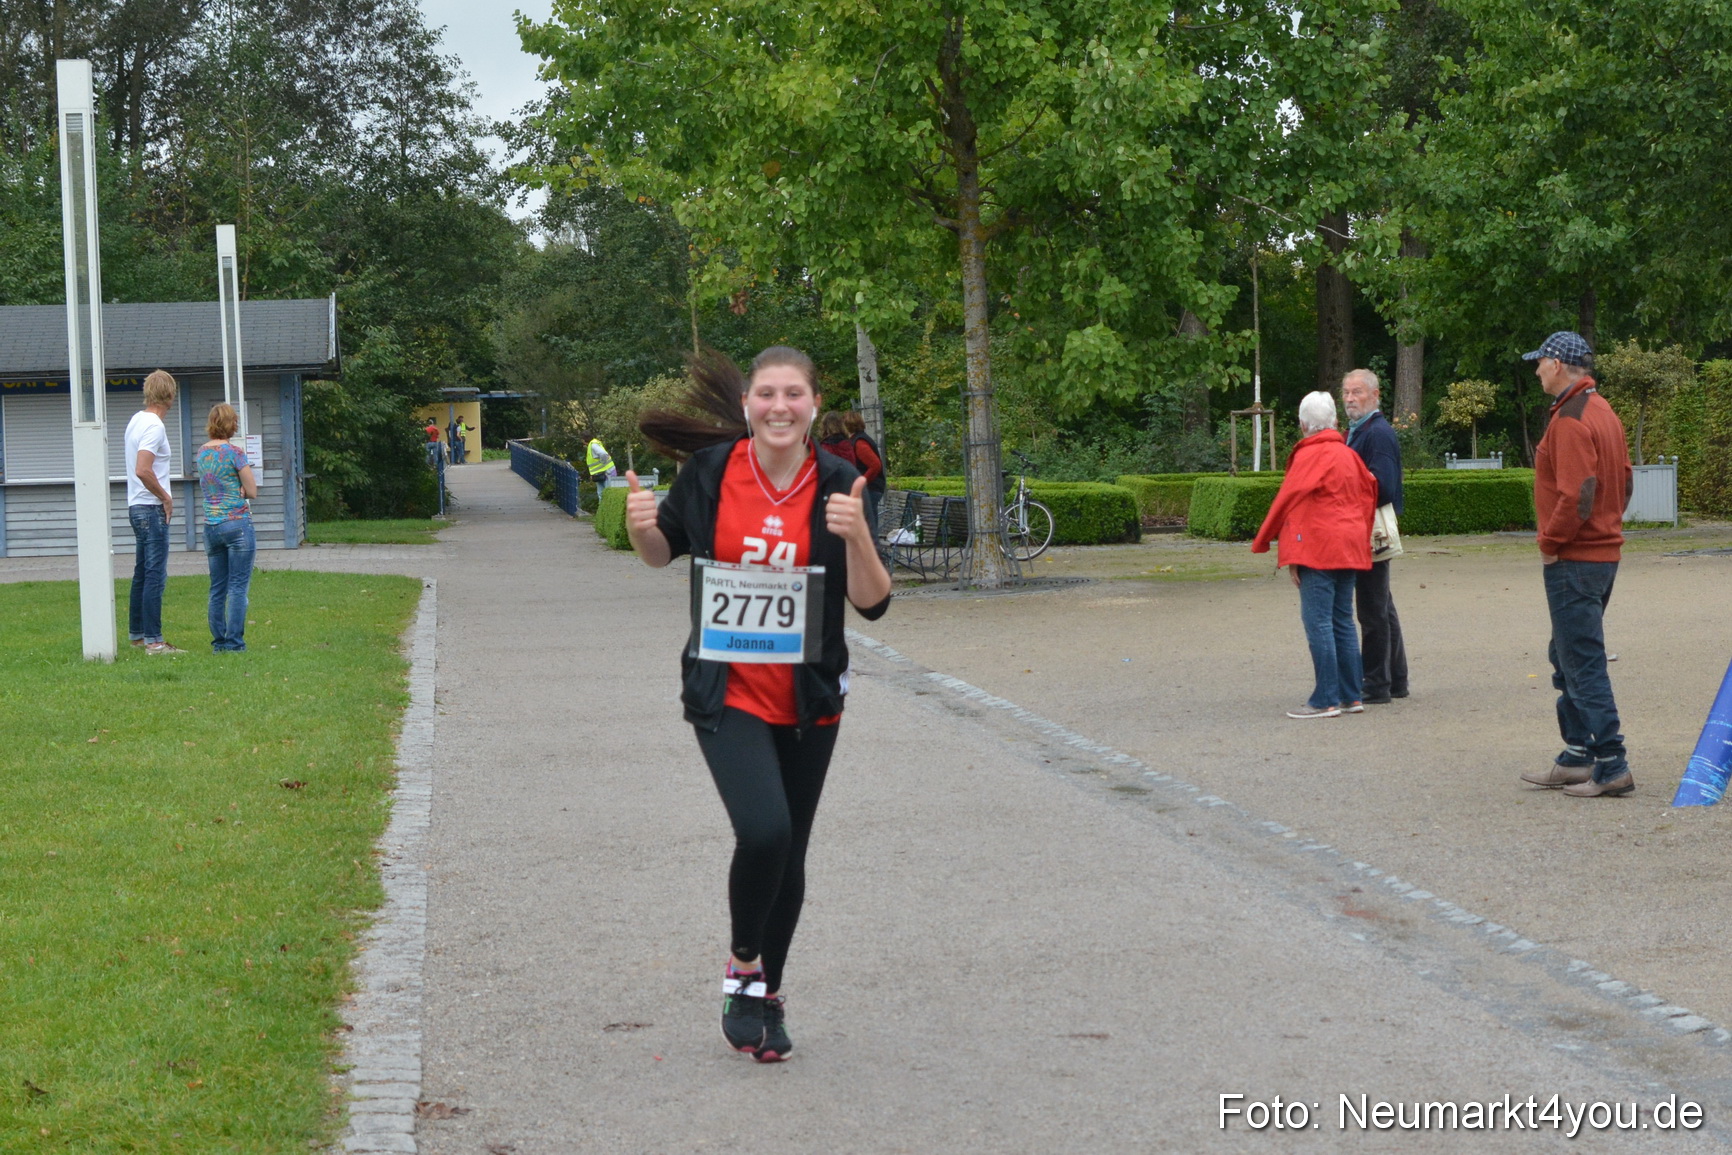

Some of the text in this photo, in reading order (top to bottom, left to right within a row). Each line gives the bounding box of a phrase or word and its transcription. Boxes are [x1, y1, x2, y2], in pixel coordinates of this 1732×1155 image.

[740, 536, 797, 567] 24
[705, 576, 788, 590] PARTL Neumarkt
[711, 592, 795, 628] 2779
[726, 636, 775, 650] Joanna
